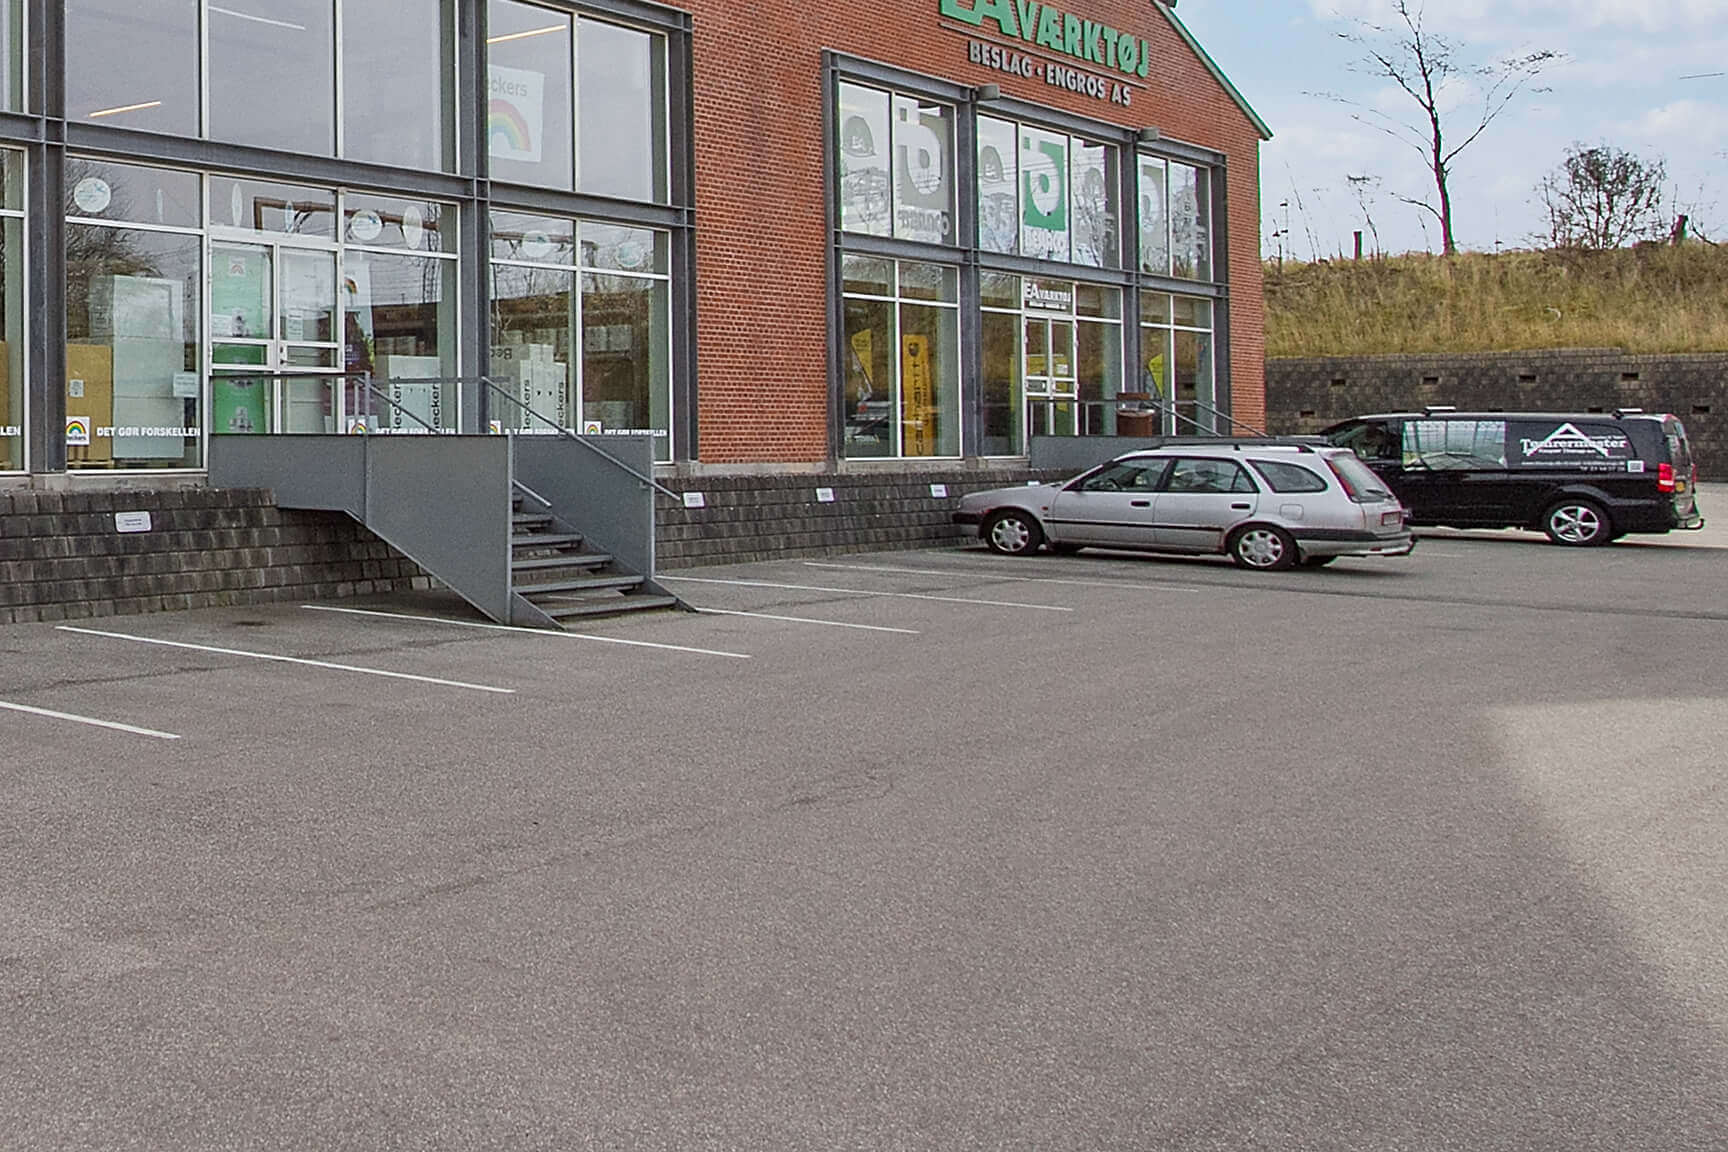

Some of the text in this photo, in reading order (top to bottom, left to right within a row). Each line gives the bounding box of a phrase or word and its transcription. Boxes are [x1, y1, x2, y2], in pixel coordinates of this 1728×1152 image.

[969, 40, 1132, 107] BESLAG ENGROS AS
[490, 75, 528, 97] ckers
[96, 427, 200, 437] DET GØR FORSKELLEN
